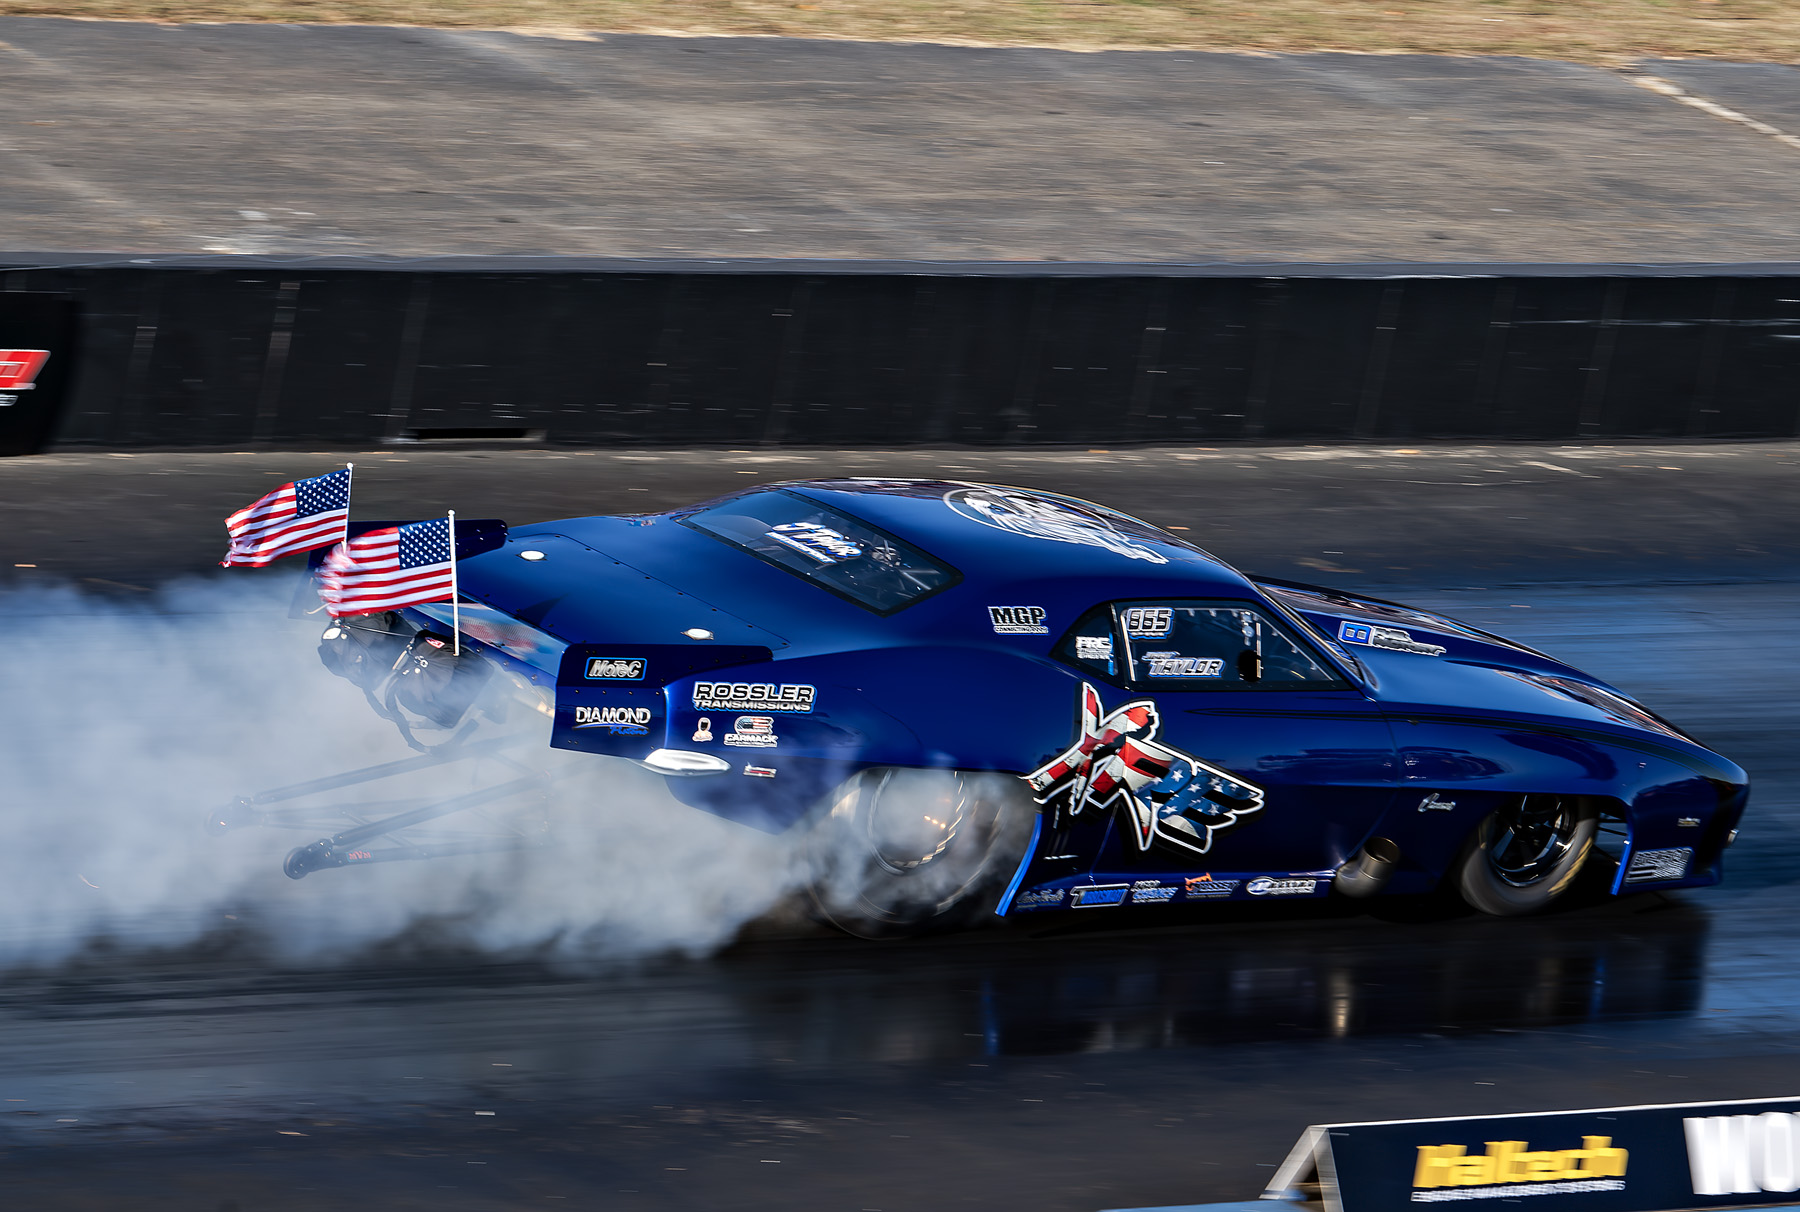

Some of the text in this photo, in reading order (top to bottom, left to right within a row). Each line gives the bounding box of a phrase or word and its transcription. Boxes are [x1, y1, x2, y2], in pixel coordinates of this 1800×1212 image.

[987, 606, 1046, 626] MGP
[1127, 608, 1172, 632] 865
[1149, 658, 1225, 676] TAYLOR
[693, 682, 815, 702] ROSSLER
[576, 707, 652, 724] DIAMOND
[693, 700, 812, 712] TRANSMISSIONS
[1683, 1117, 1800, 1197] WO
